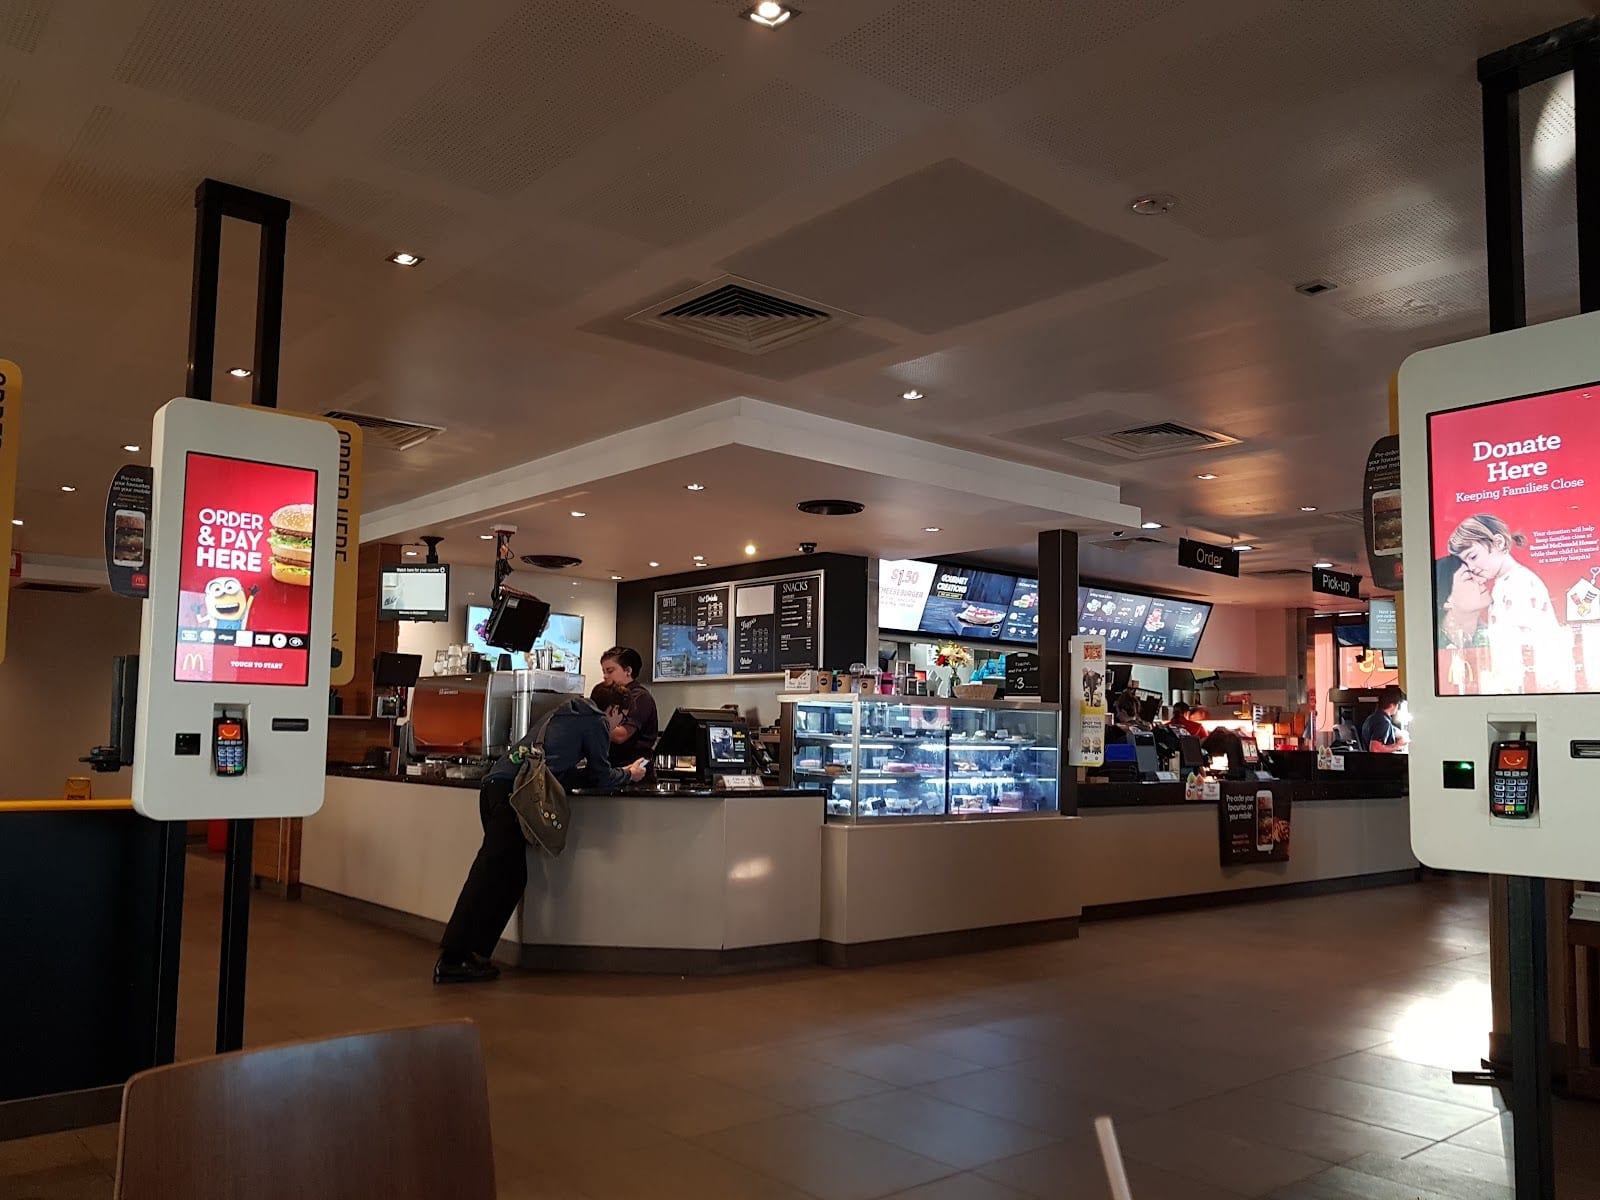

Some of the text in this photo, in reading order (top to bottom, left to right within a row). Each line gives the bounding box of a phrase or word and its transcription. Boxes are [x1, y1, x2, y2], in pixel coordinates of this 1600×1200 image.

[1473, 434, 1562, 462] Donate
[1487, 460, 1548, 482] Here
[1456, 477, 1585, 503] Keeping Families Close
[199, 508, 263, 530] ORDER
[198, 525, 263, 551] & PAY
[196, 546, 262, 572] HERE
[1197, 548, 1223, 566] Order
[782, 581, 808, 593] SNACKS
[1323, 574, 1350, 593] Pick-up
[230, 660, 254, 668] TOUCH
[1245, 795, 1255, 803] your
[1229, 814, 1239, 822] your
